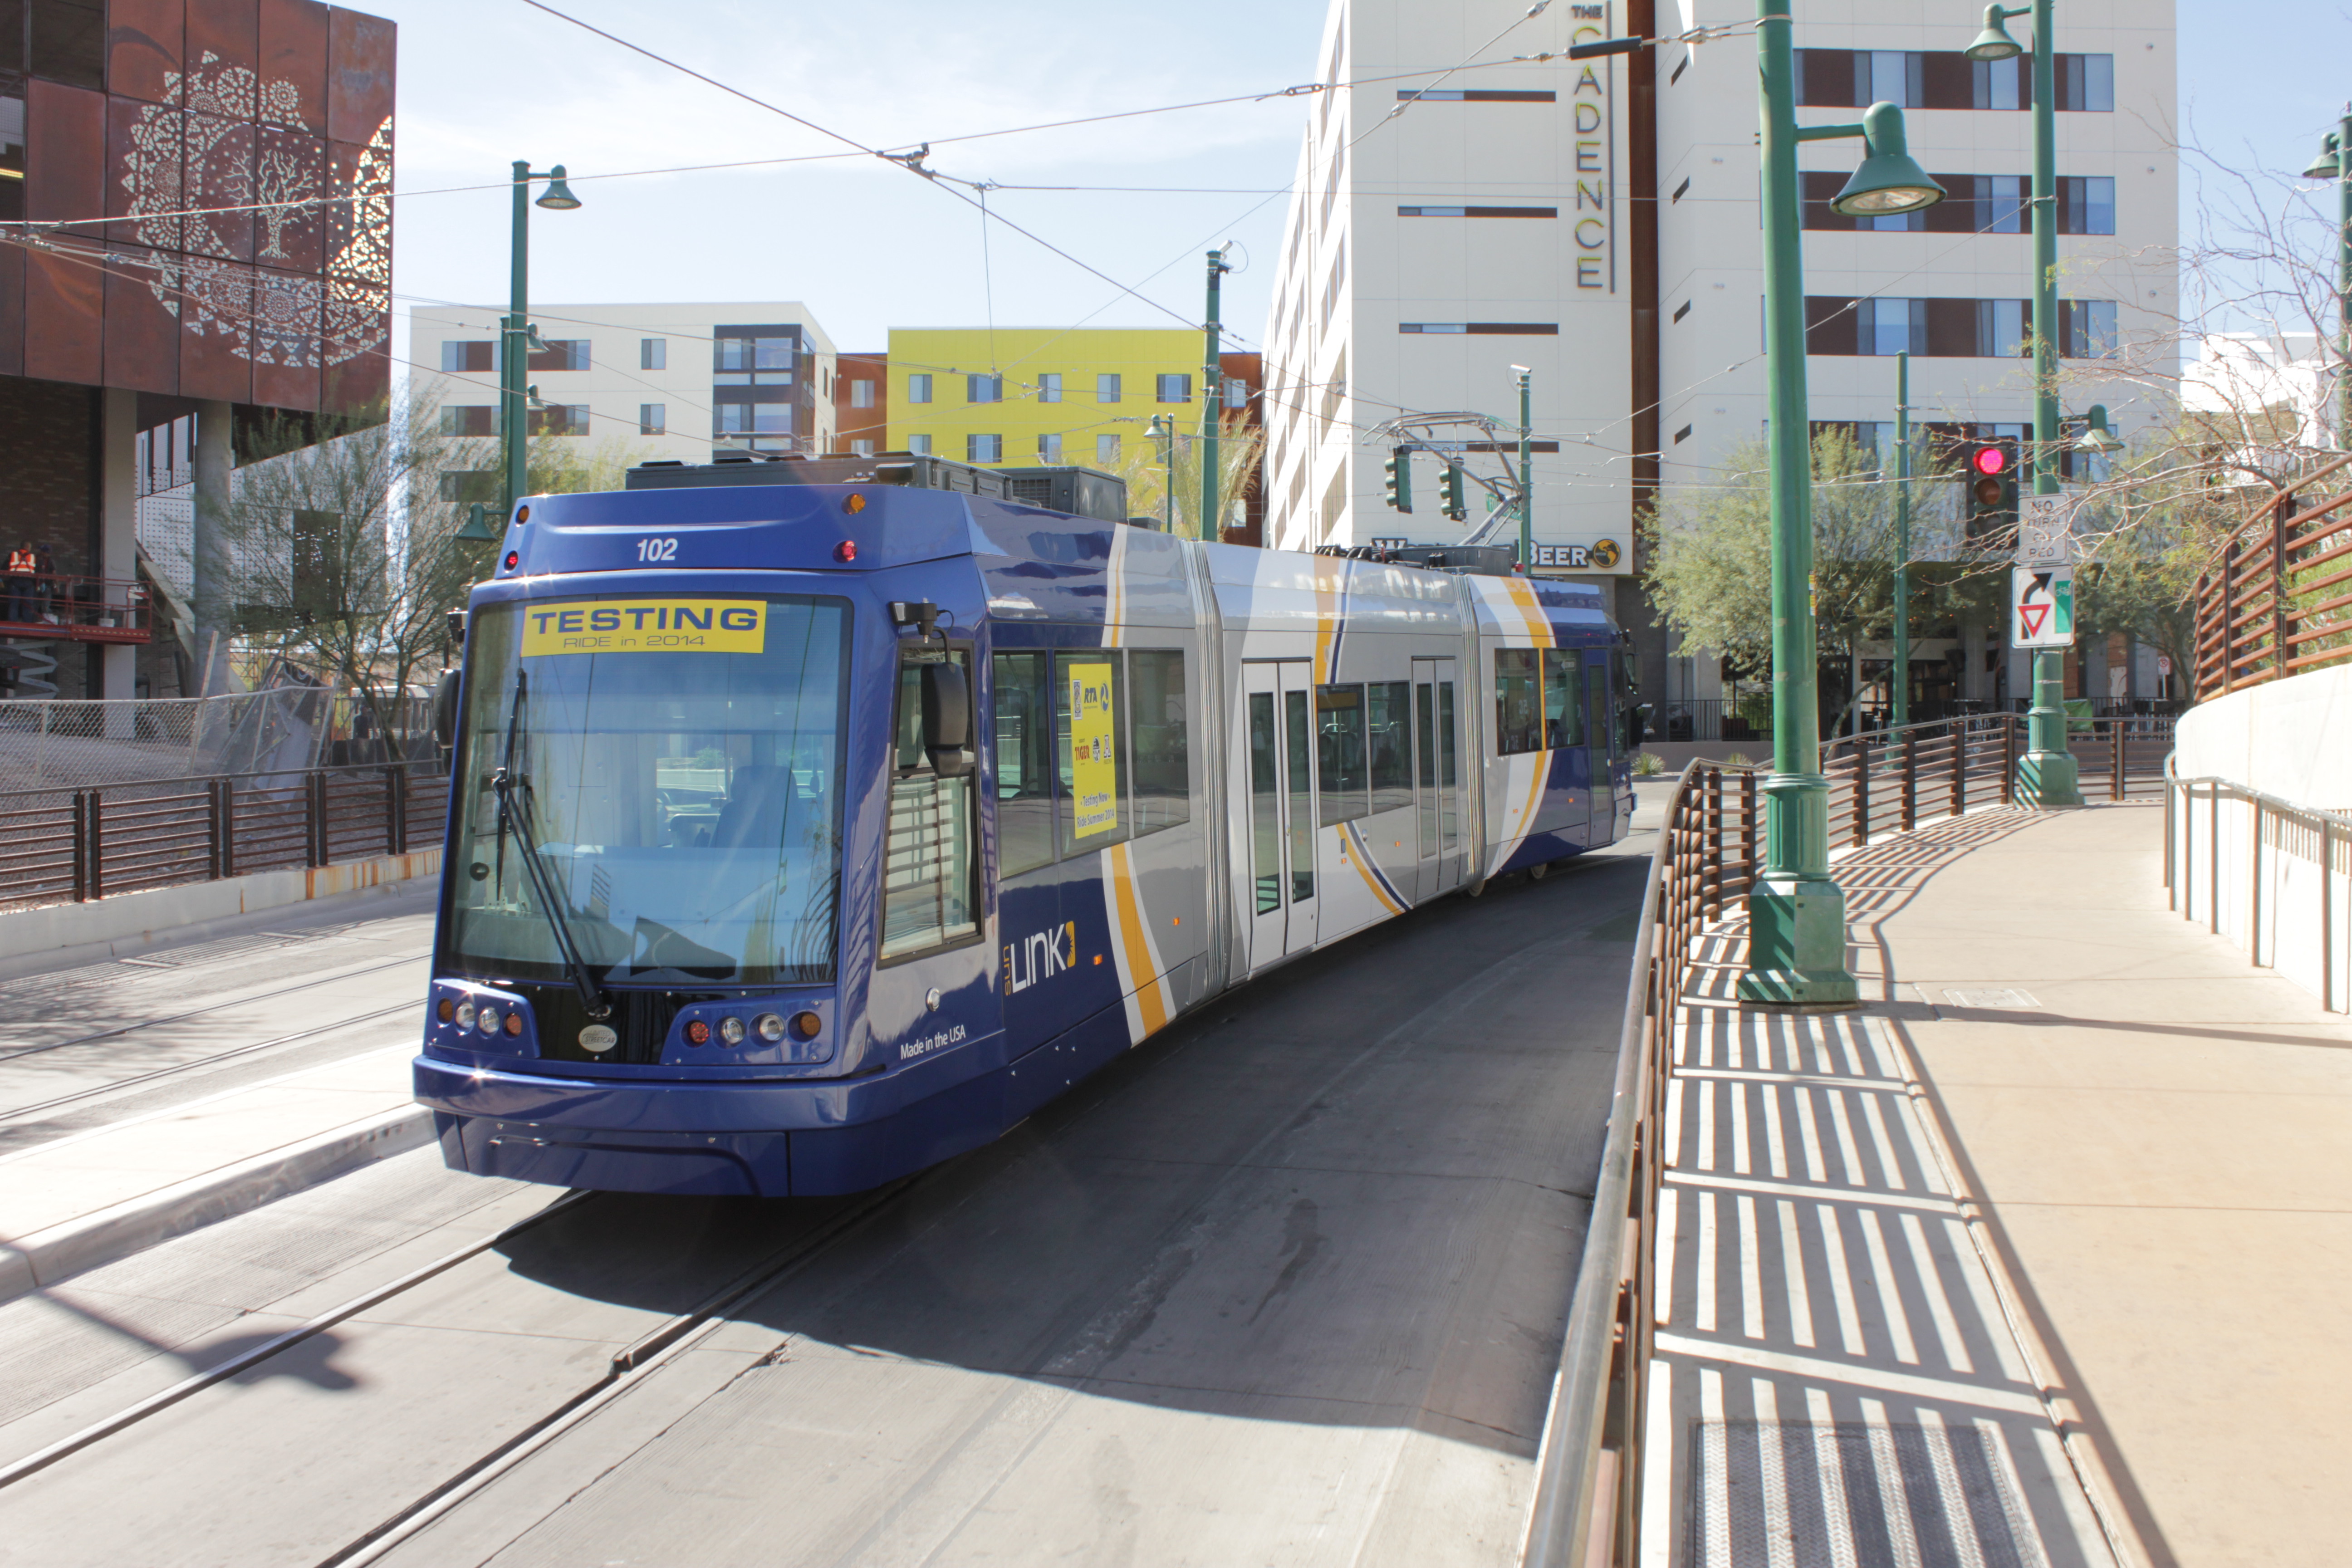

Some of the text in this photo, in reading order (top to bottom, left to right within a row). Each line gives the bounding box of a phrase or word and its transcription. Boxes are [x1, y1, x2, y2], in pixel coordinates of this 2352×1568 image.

[1571, 5, 1603, 19] THE
[1573, 25, 1605, 289] CADENCE
[2031, 500, 2053, 512] NO
[2026, 517, 2060, 527] TURN
[637, 538, 678, 561] 102
[1530, 541, 1587, 566] BEER
[2029, 548, 2054, 558] RED
[532, 608, 758, 634] TESTING
[564, 636, 706, 648] RIDE in 2014
[1084, 687, 1098, 704] RTA
[1075, 745, 1090, 761] TIGER
[1083, 792, 1108, 807] Testing Now
[1077, 808, 1115, 828] Ride Summer 2014
[901, 1024, 966, 1060] Made in the USA
